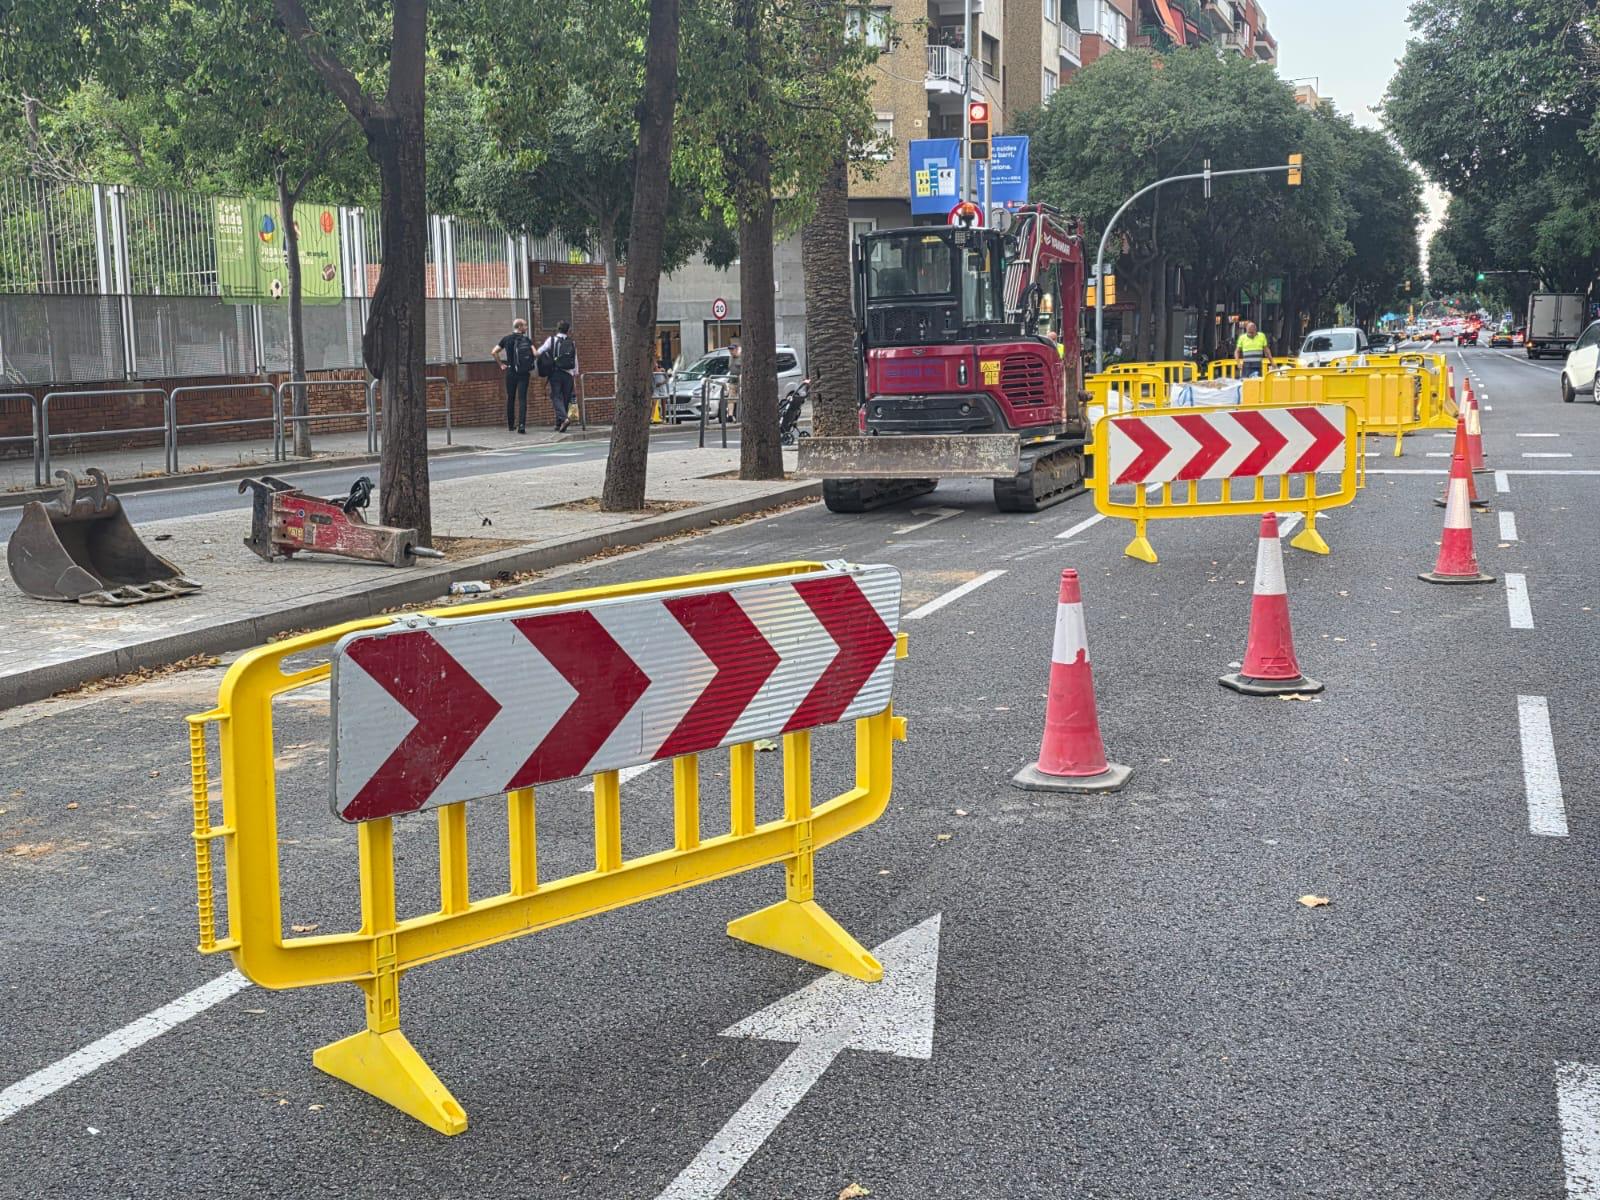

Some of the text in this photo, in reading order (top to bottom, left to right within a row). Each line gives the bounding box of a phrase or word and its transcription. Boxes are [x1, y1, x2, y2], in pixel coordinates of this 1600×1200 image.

[219, 212, 242, 225] kids
[219, 225, 243, 236] camp
[1052, 236, 1070, 256] YANMAR
